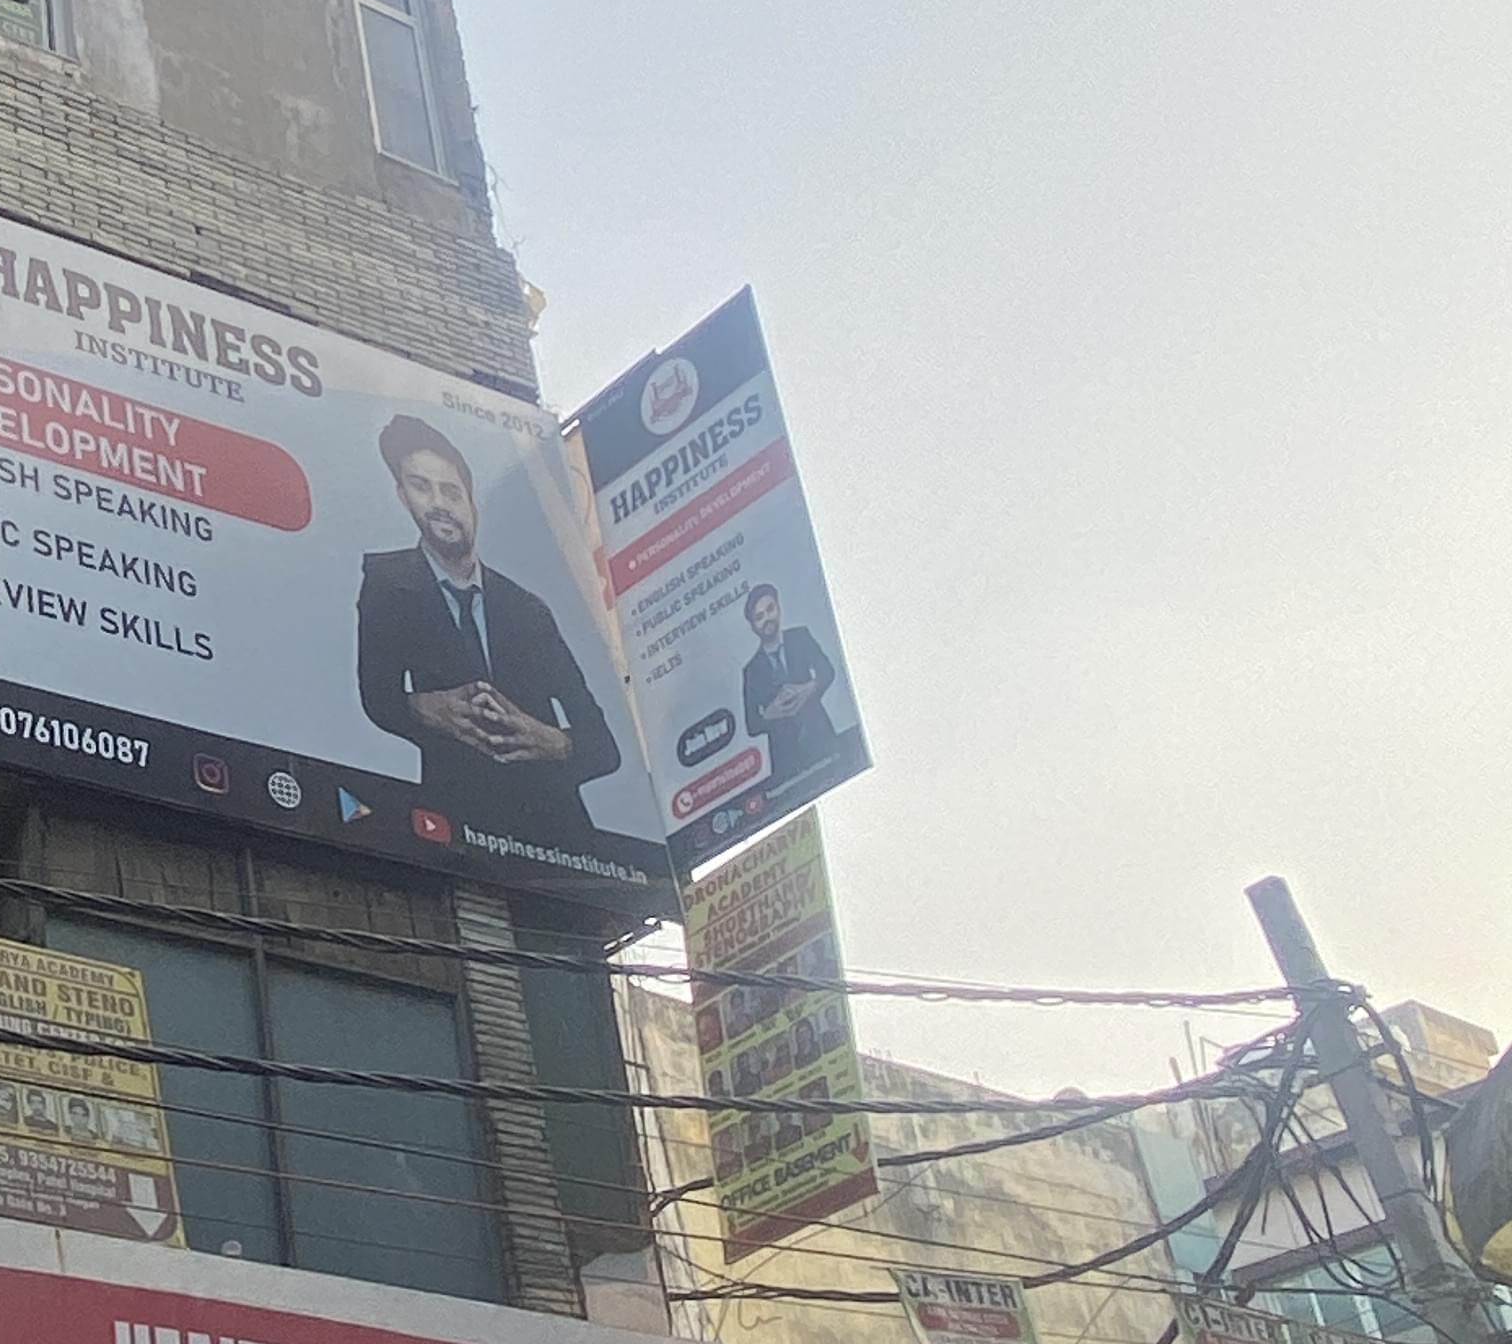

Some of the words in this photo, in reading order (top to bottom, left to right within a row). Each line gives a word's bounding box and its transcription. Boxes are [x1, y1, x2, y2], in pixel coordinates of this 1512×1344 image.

[74, 329, 246, 405] INSTITUTE
[440, 390, 496, 425] Since
[499, 411, 545, 441] 2012
[609, 391, 764, 526] HAPPINESS
[52, 472, 214, 543] SPEAKING
[32, 528, 198, 599] SPEAKING
[99, 606, 215, 662] SKILLS
[463, 823, 649, 887] happinessinstitute.in
[36, 957, 115, 988] ACADEMY
[56, 982, 136, 1018] STENO
